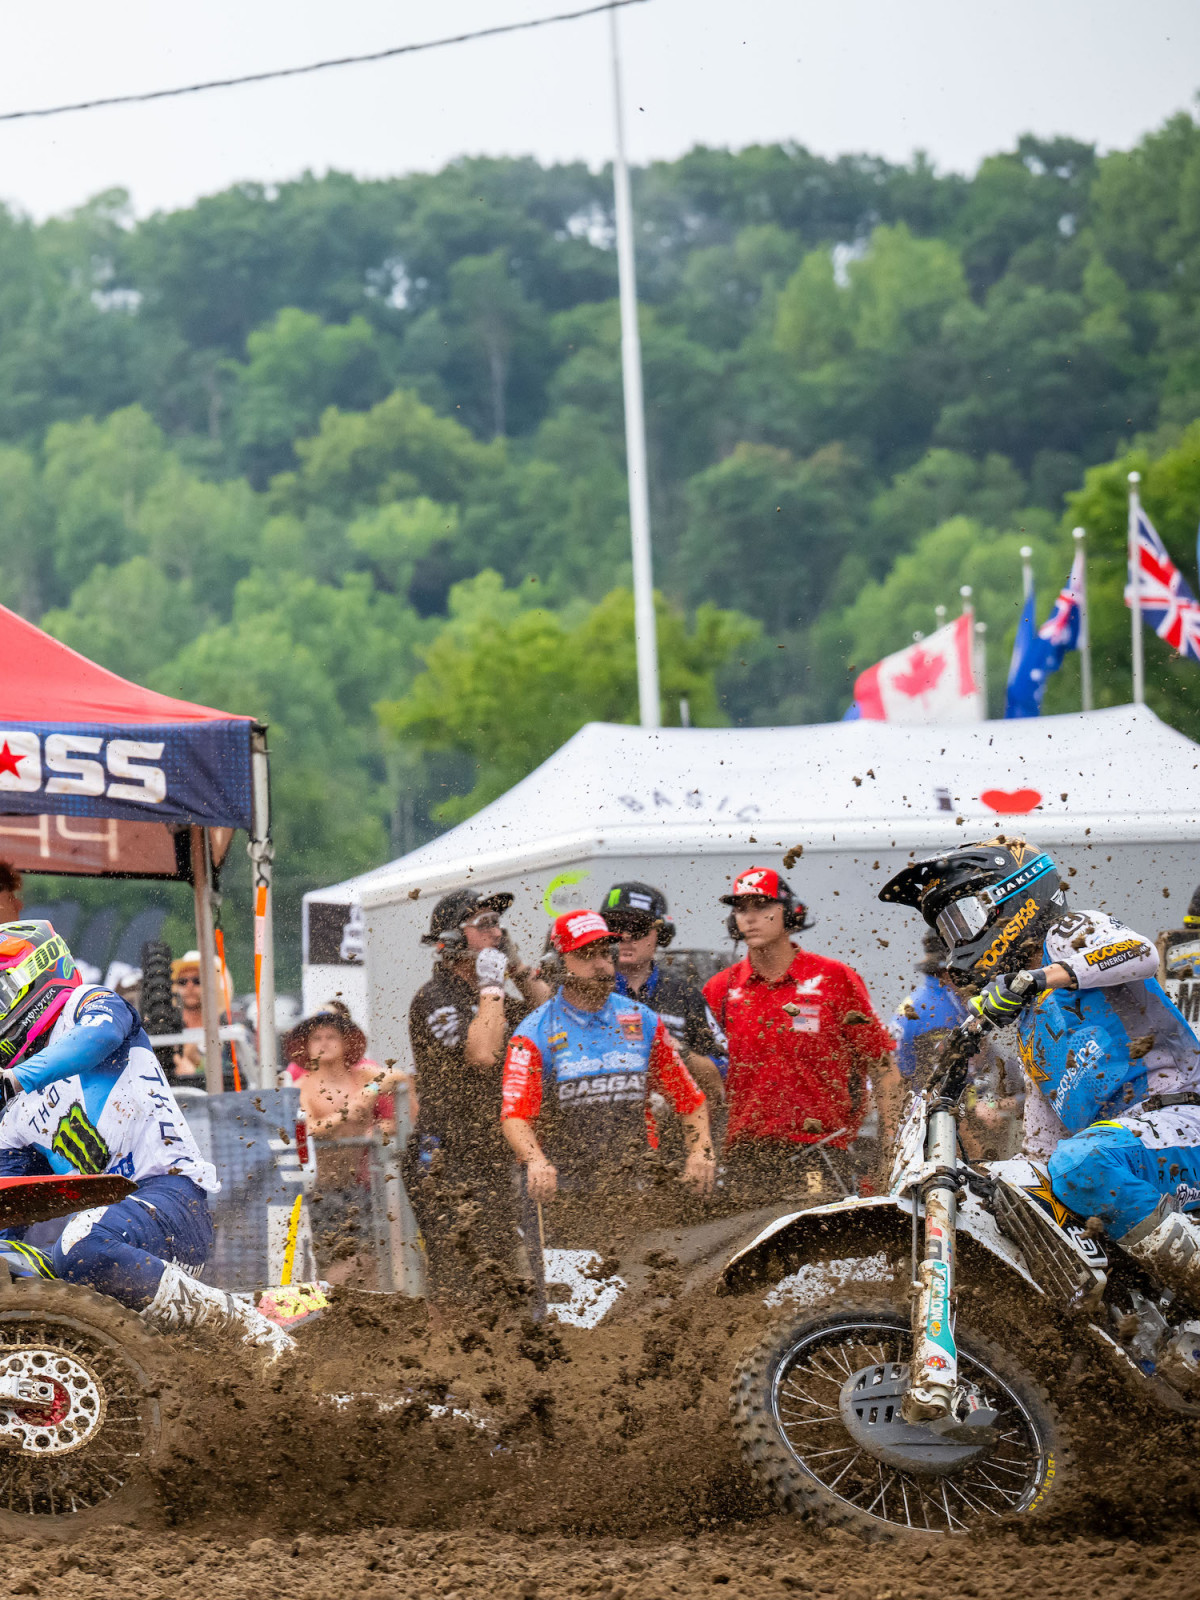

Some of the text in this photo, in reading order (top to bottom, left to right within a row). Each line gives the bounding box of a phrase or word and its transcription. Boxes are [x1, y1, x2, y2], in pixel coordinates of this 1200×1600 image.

[995, 860, 1045, 897] OAKLEY
[1099, 949, 1128, 971] ENERGY
[21, 987, 57, 1028] MONSTER
